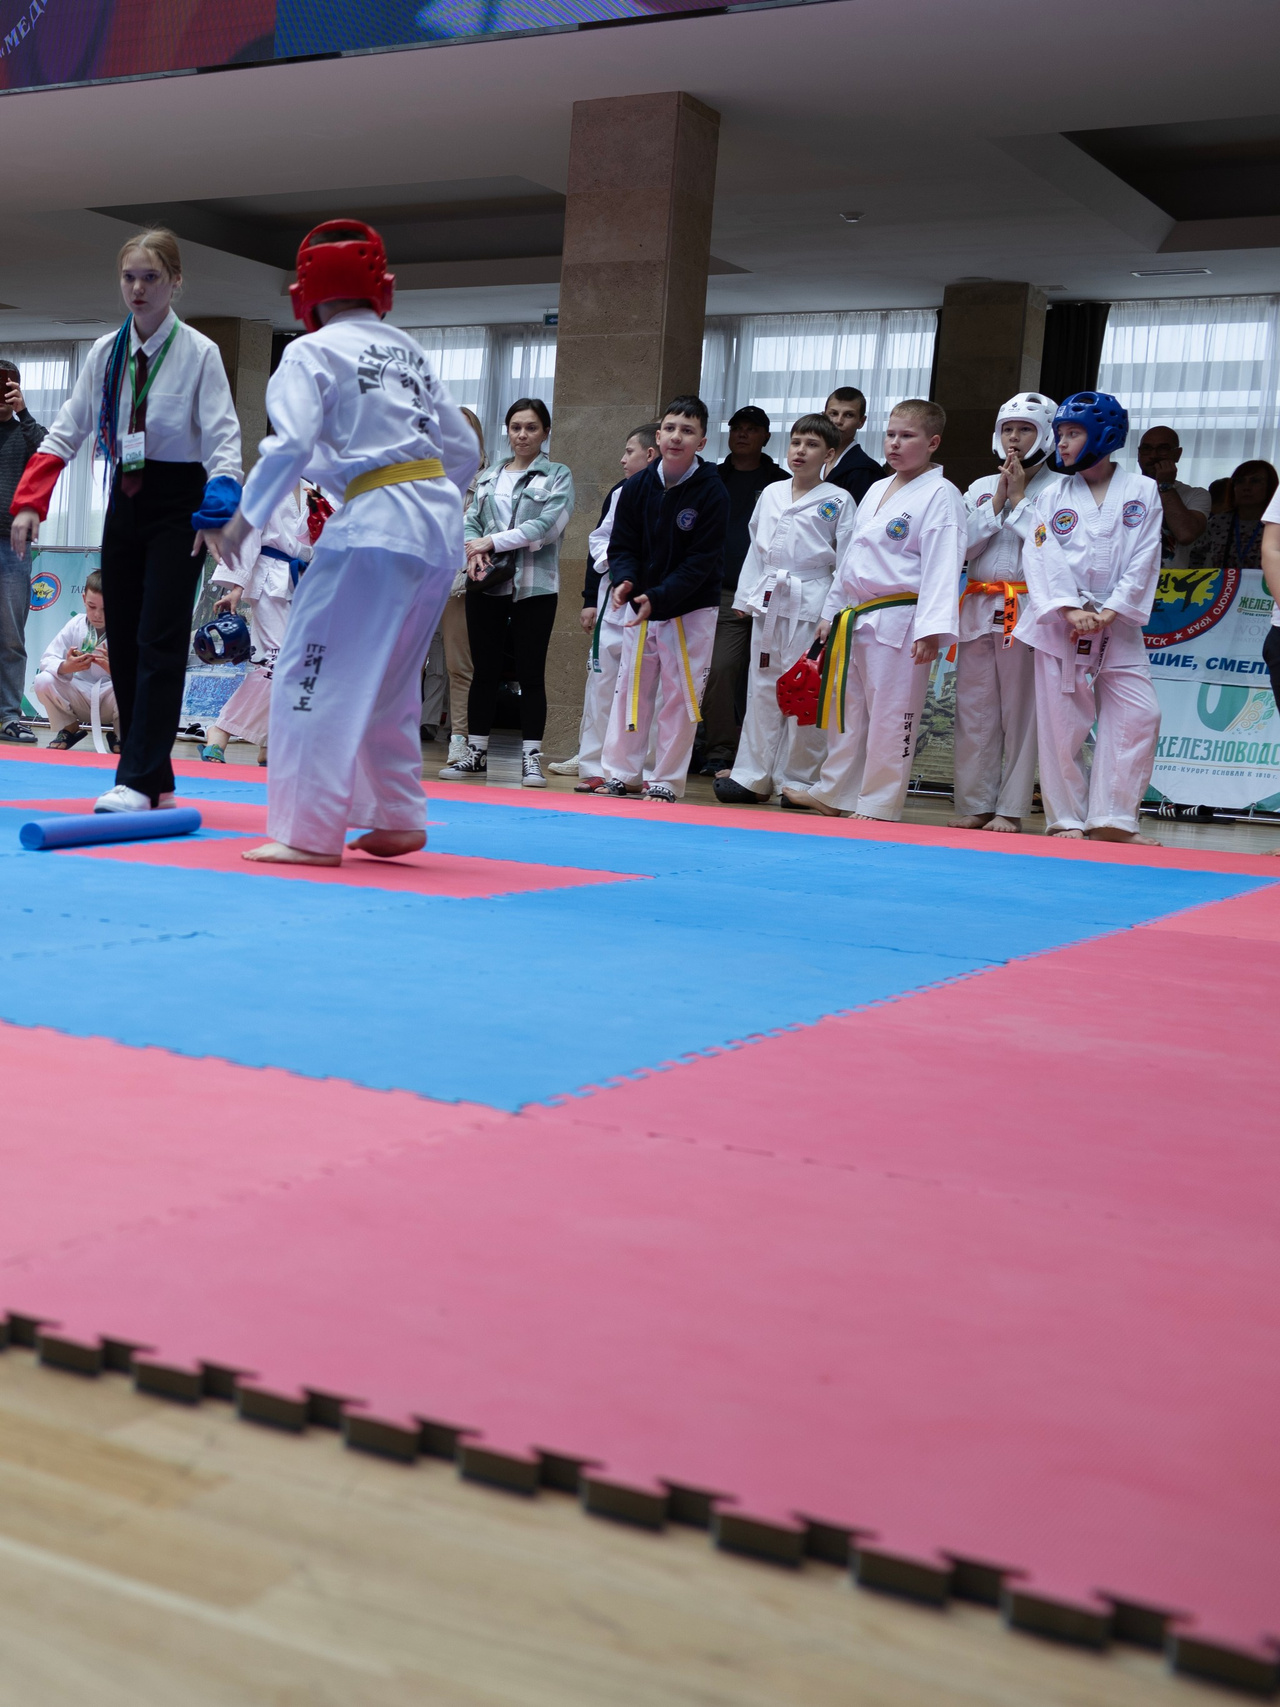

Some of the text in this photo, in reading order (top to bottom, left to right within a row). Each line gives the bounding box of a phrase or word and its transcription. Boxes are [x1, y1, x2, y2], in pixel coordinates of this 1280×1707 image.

[1187, 616, 1212, 634] КРАЯ
[1143, 635, 1168, 646] ТСК
[306, 643, 327, 654] ITF
[1154, 764, 1210, 775] ГОРОД-КУРОРТ
[1211, 769, 1245, 777] ОСНОВАН
